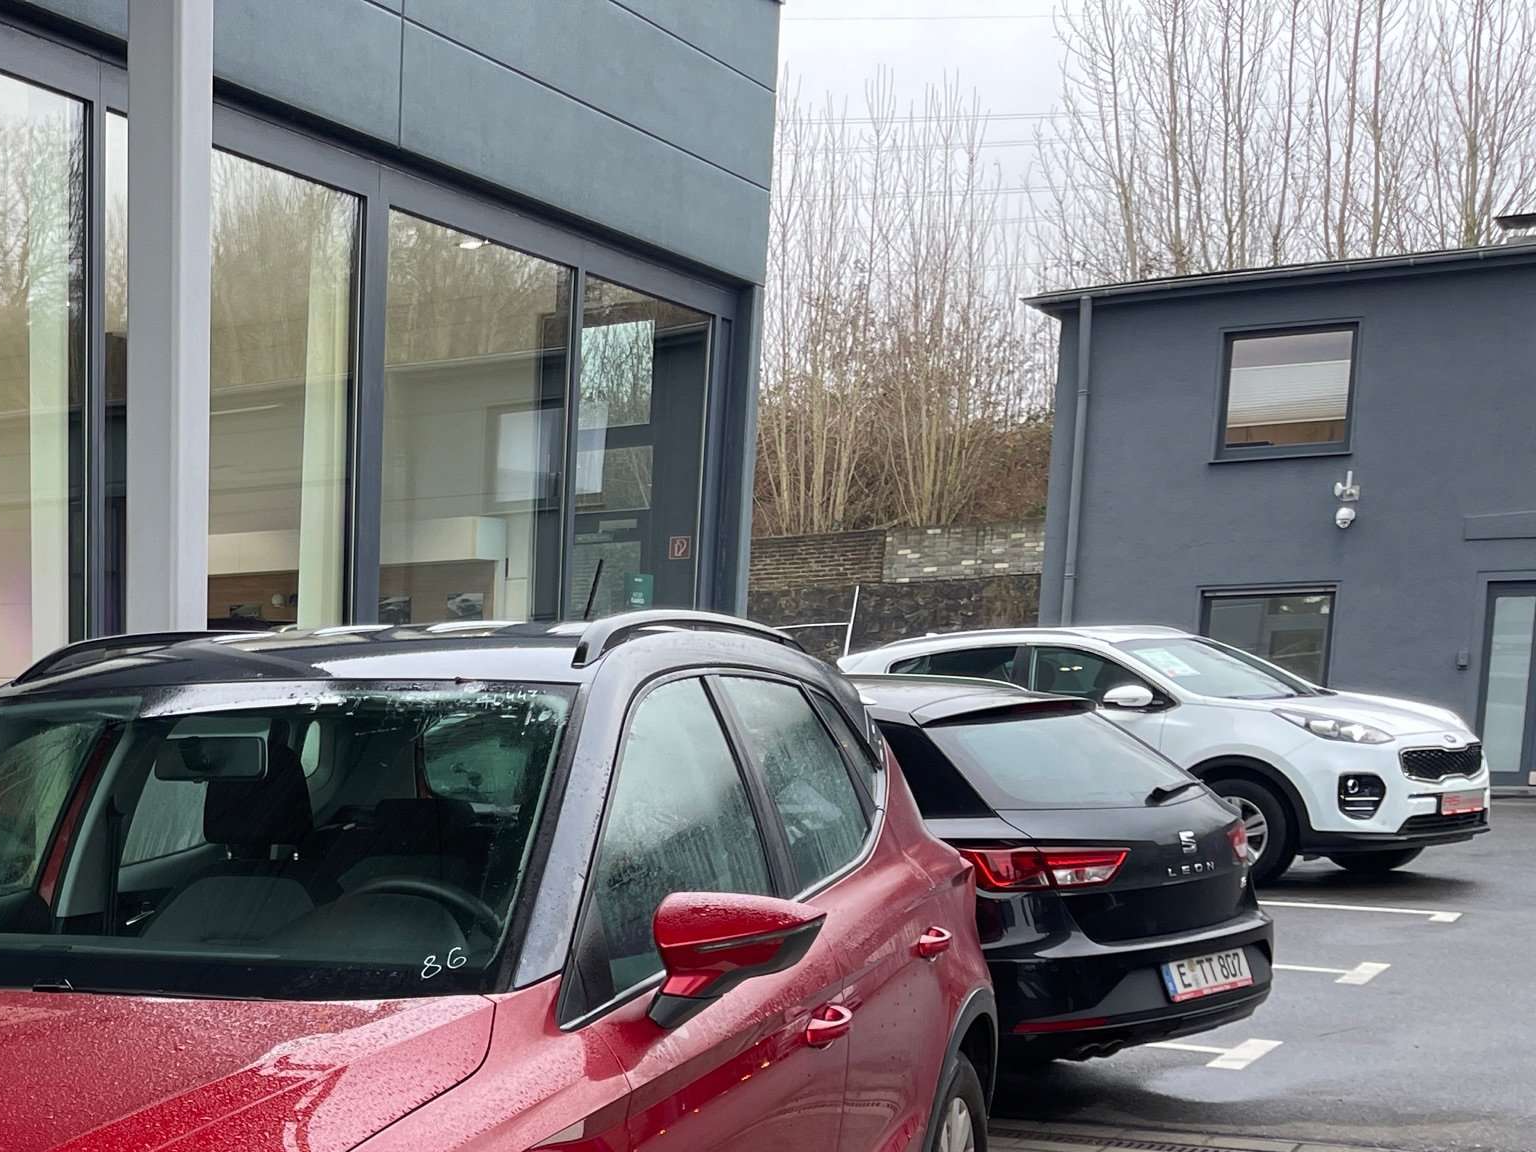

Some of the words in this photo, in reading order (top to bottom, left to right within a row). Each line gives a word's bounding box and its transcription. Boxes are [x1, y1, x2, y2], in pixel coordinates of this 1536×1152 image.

[1167, 861, 1215, 877] LEON
[420, 946, 467, 980] 86
[1176, 963, 1192, 988] E
[1196, 957, 1218, 984] TT
